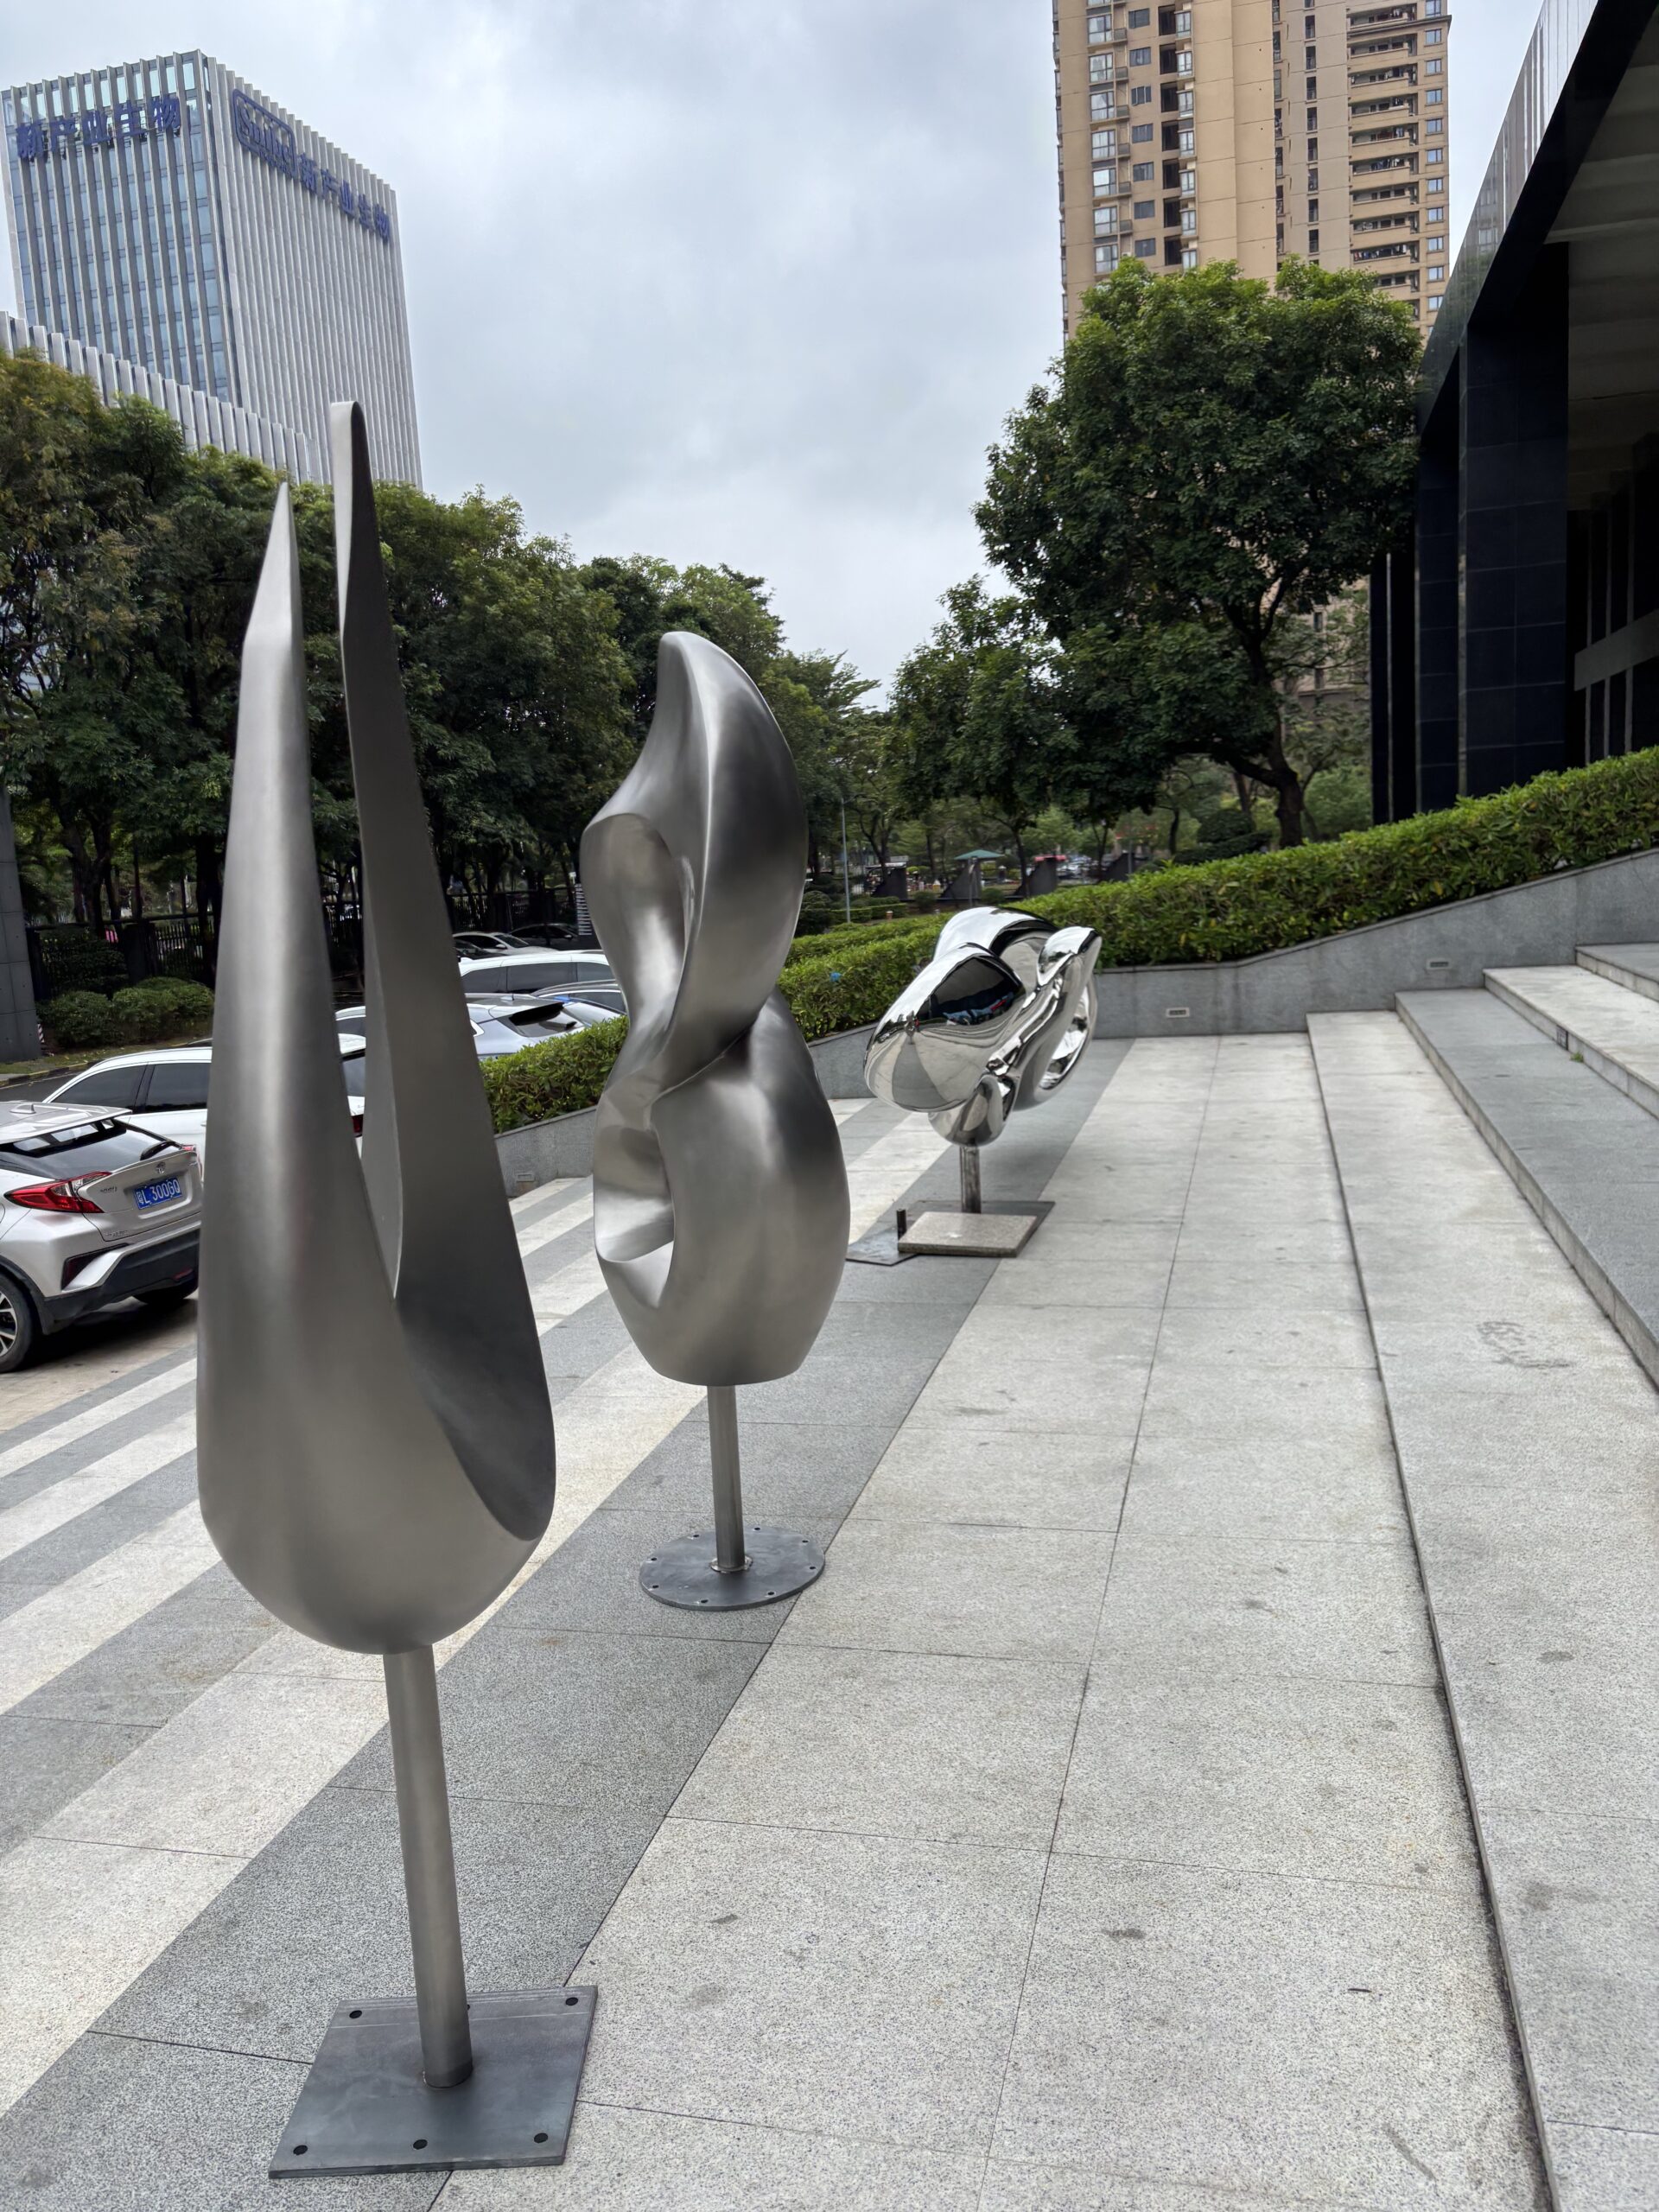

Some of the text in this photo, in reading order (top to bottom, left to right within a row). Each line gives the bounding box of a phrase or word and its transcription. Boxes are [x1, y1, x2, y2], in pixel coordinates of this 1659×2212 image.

[16, 94, 181, 159] 新产业生物
[300, 152, 391, 242] 新产业生物
